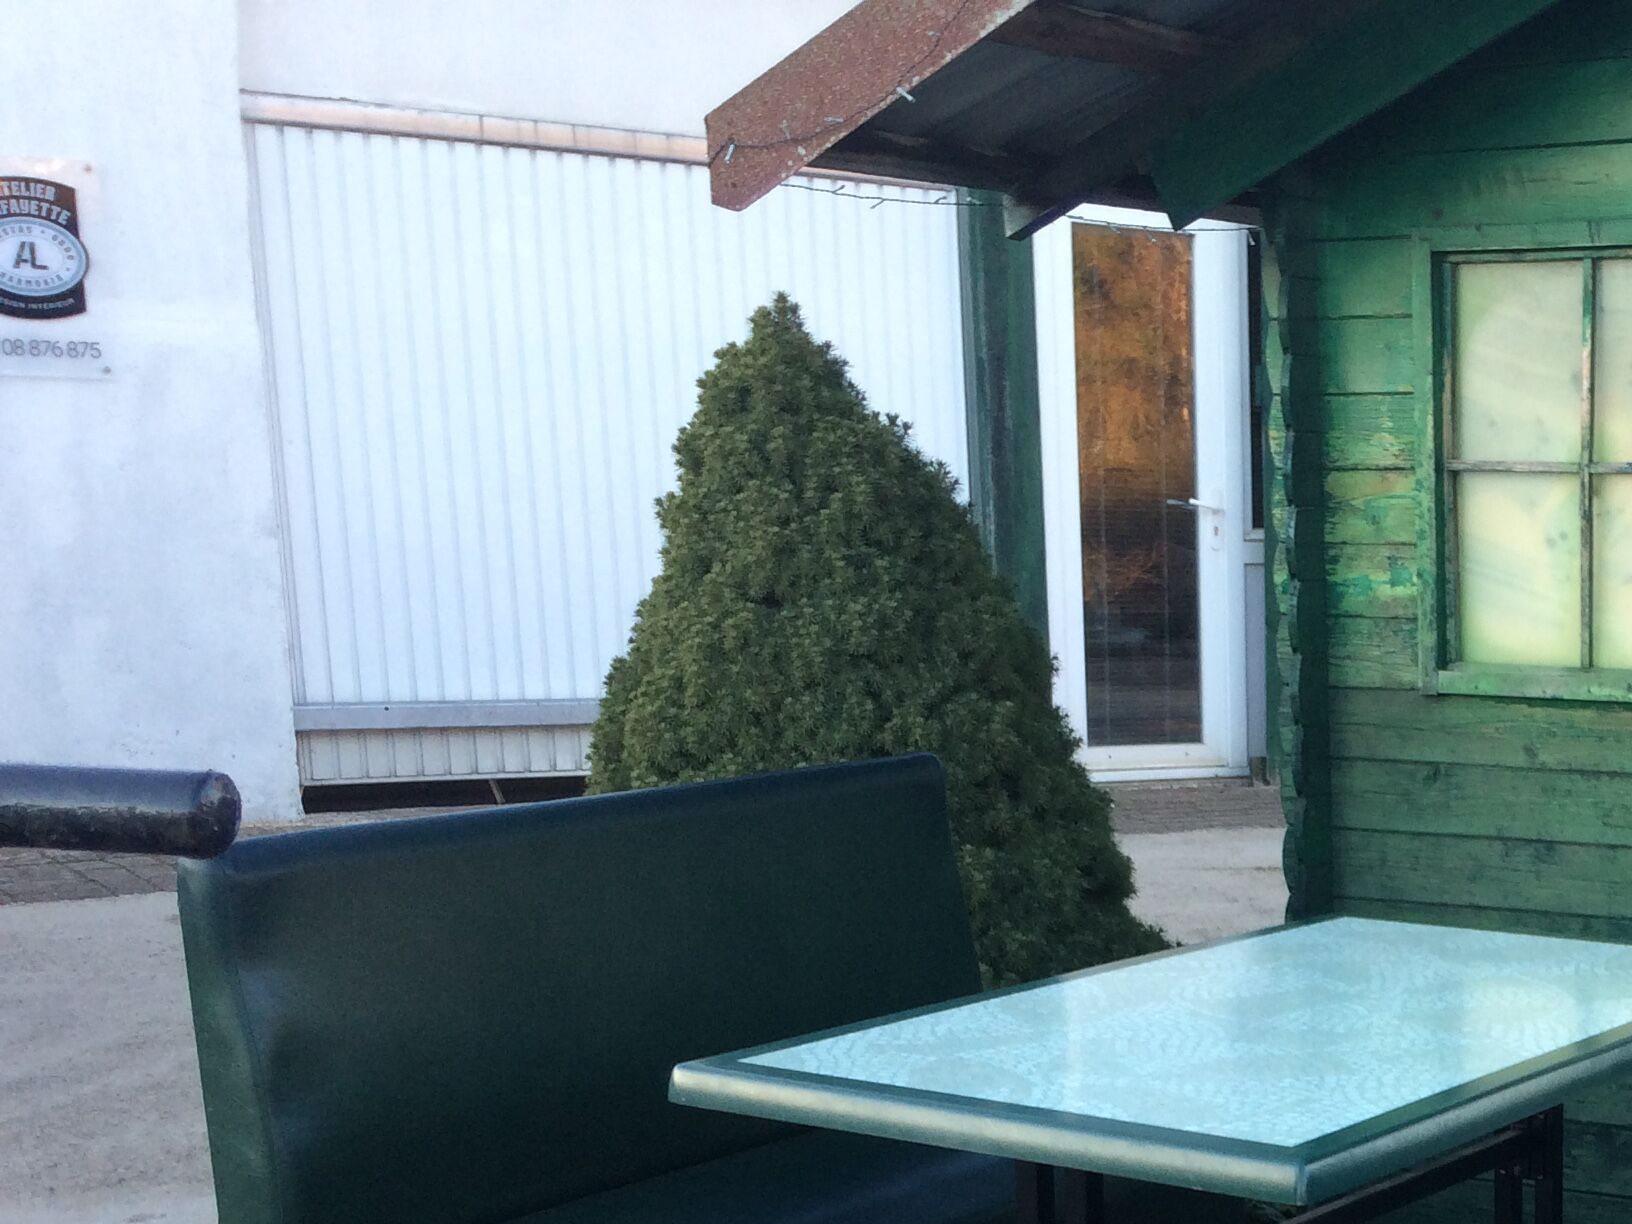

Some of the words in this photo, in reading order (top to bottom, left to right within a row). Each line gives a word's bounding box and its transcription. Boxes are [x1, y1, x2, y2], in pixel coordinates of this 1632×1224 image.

[0, 181, 56, 201] TELIER
[0, 199, 72, 225] FAYETTE
[2, 338, 25, 356] 08
[29, 339, 64, 358] 876
[67, 340, 102, 359] 875
